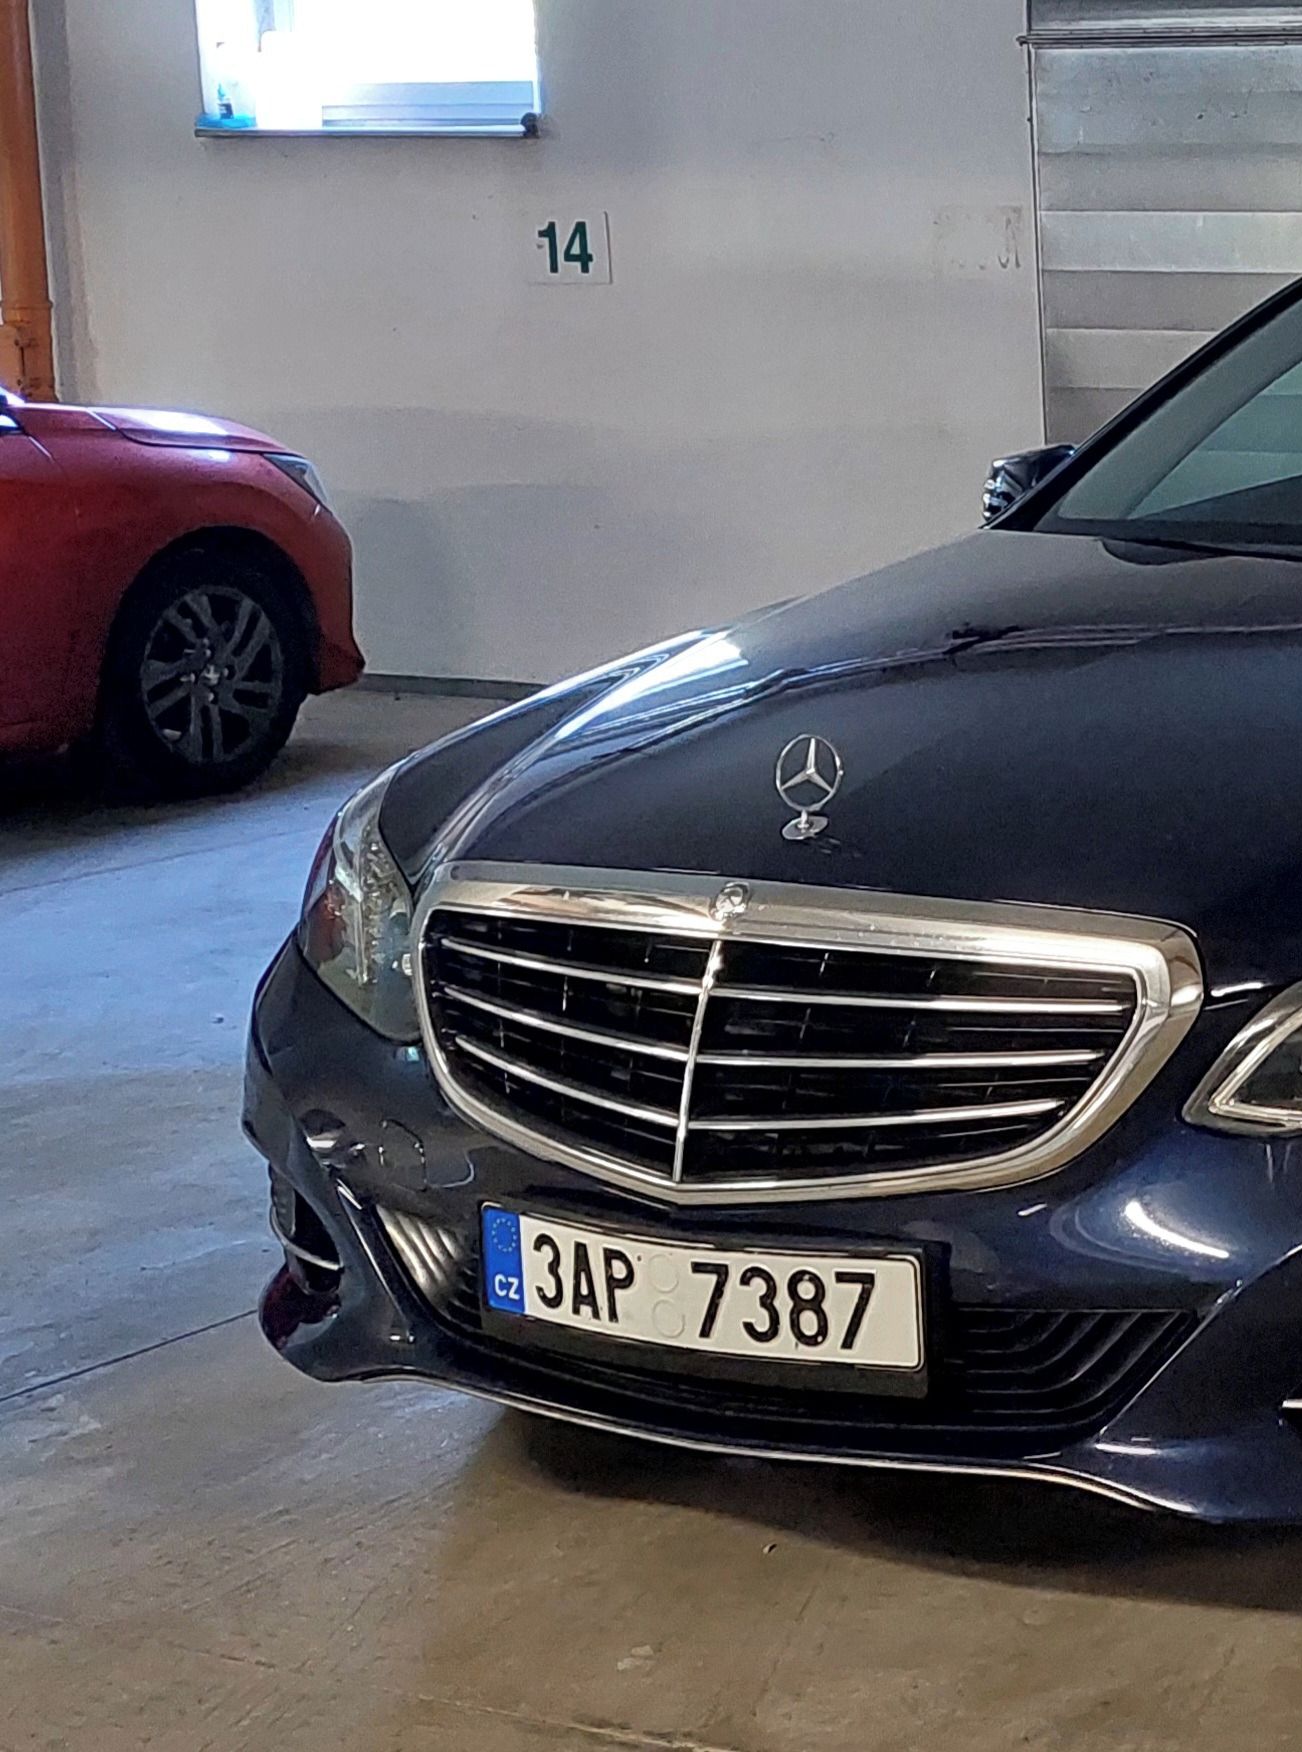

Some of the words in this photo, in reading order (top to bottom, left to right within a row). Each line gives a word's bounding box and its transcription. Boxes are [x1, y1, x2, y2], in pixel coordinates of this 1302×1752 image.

[538, 221, 593, 273] 14
[494, 1276, 520, 1300] CZ
[533, 1233, 635, 1323] 3AP
[690, 1261, 876, 1350] 7387
